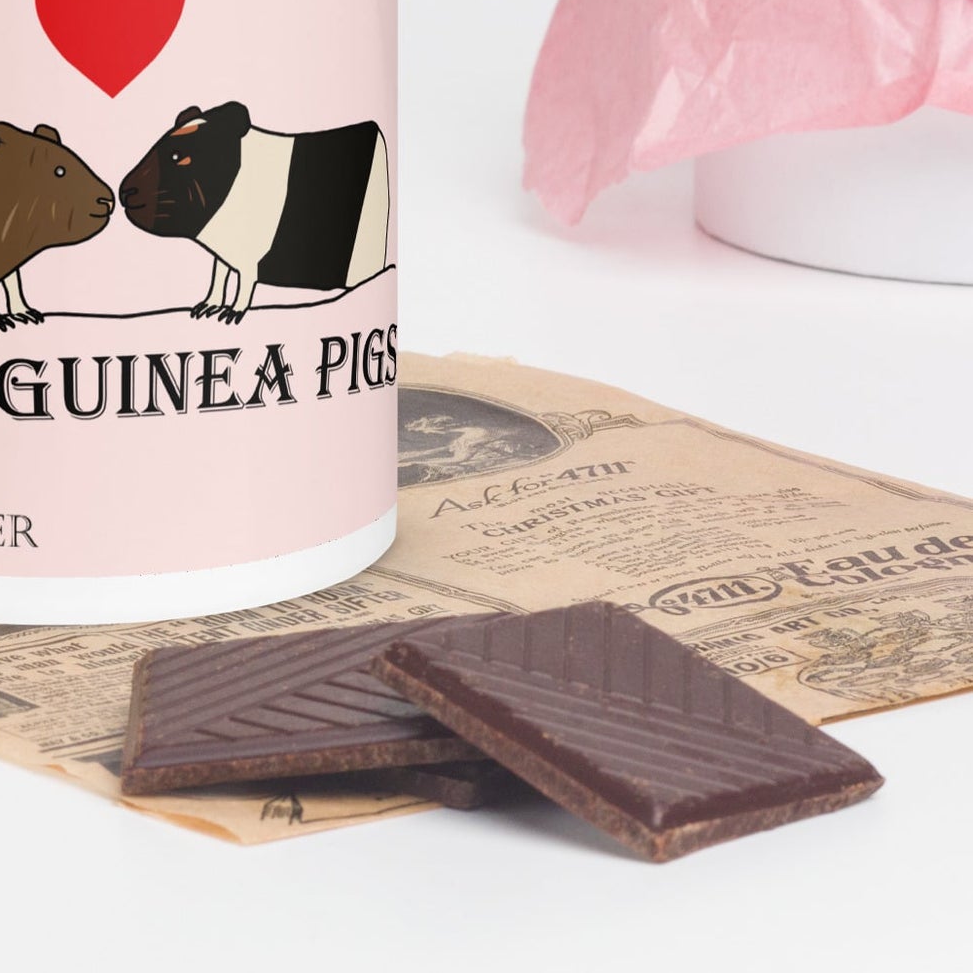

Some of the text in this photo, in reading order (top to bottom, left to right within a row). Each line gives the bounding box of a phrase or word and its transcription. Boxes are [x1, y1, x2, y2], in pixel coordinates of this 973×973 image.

[314, 323, 397, 400] PIGS
[429, 484, 502, 519] Ask
[507, 476, 553, 495] for
[482, 493, 647, 537] CHRISTMAS
[654, 486, 716, 498] GIFT
[779, 545, 909, 576] Eau
[913, 535, 973, 556] de
[324, 589, 413, 615] SIFTER
[120, 626, 180, 641] THE
[770, 616, 821, 635] ART
[15, 657, 62, 672] man
[70, 641, 141, 662] would
[28, 641, 89, 658] what
